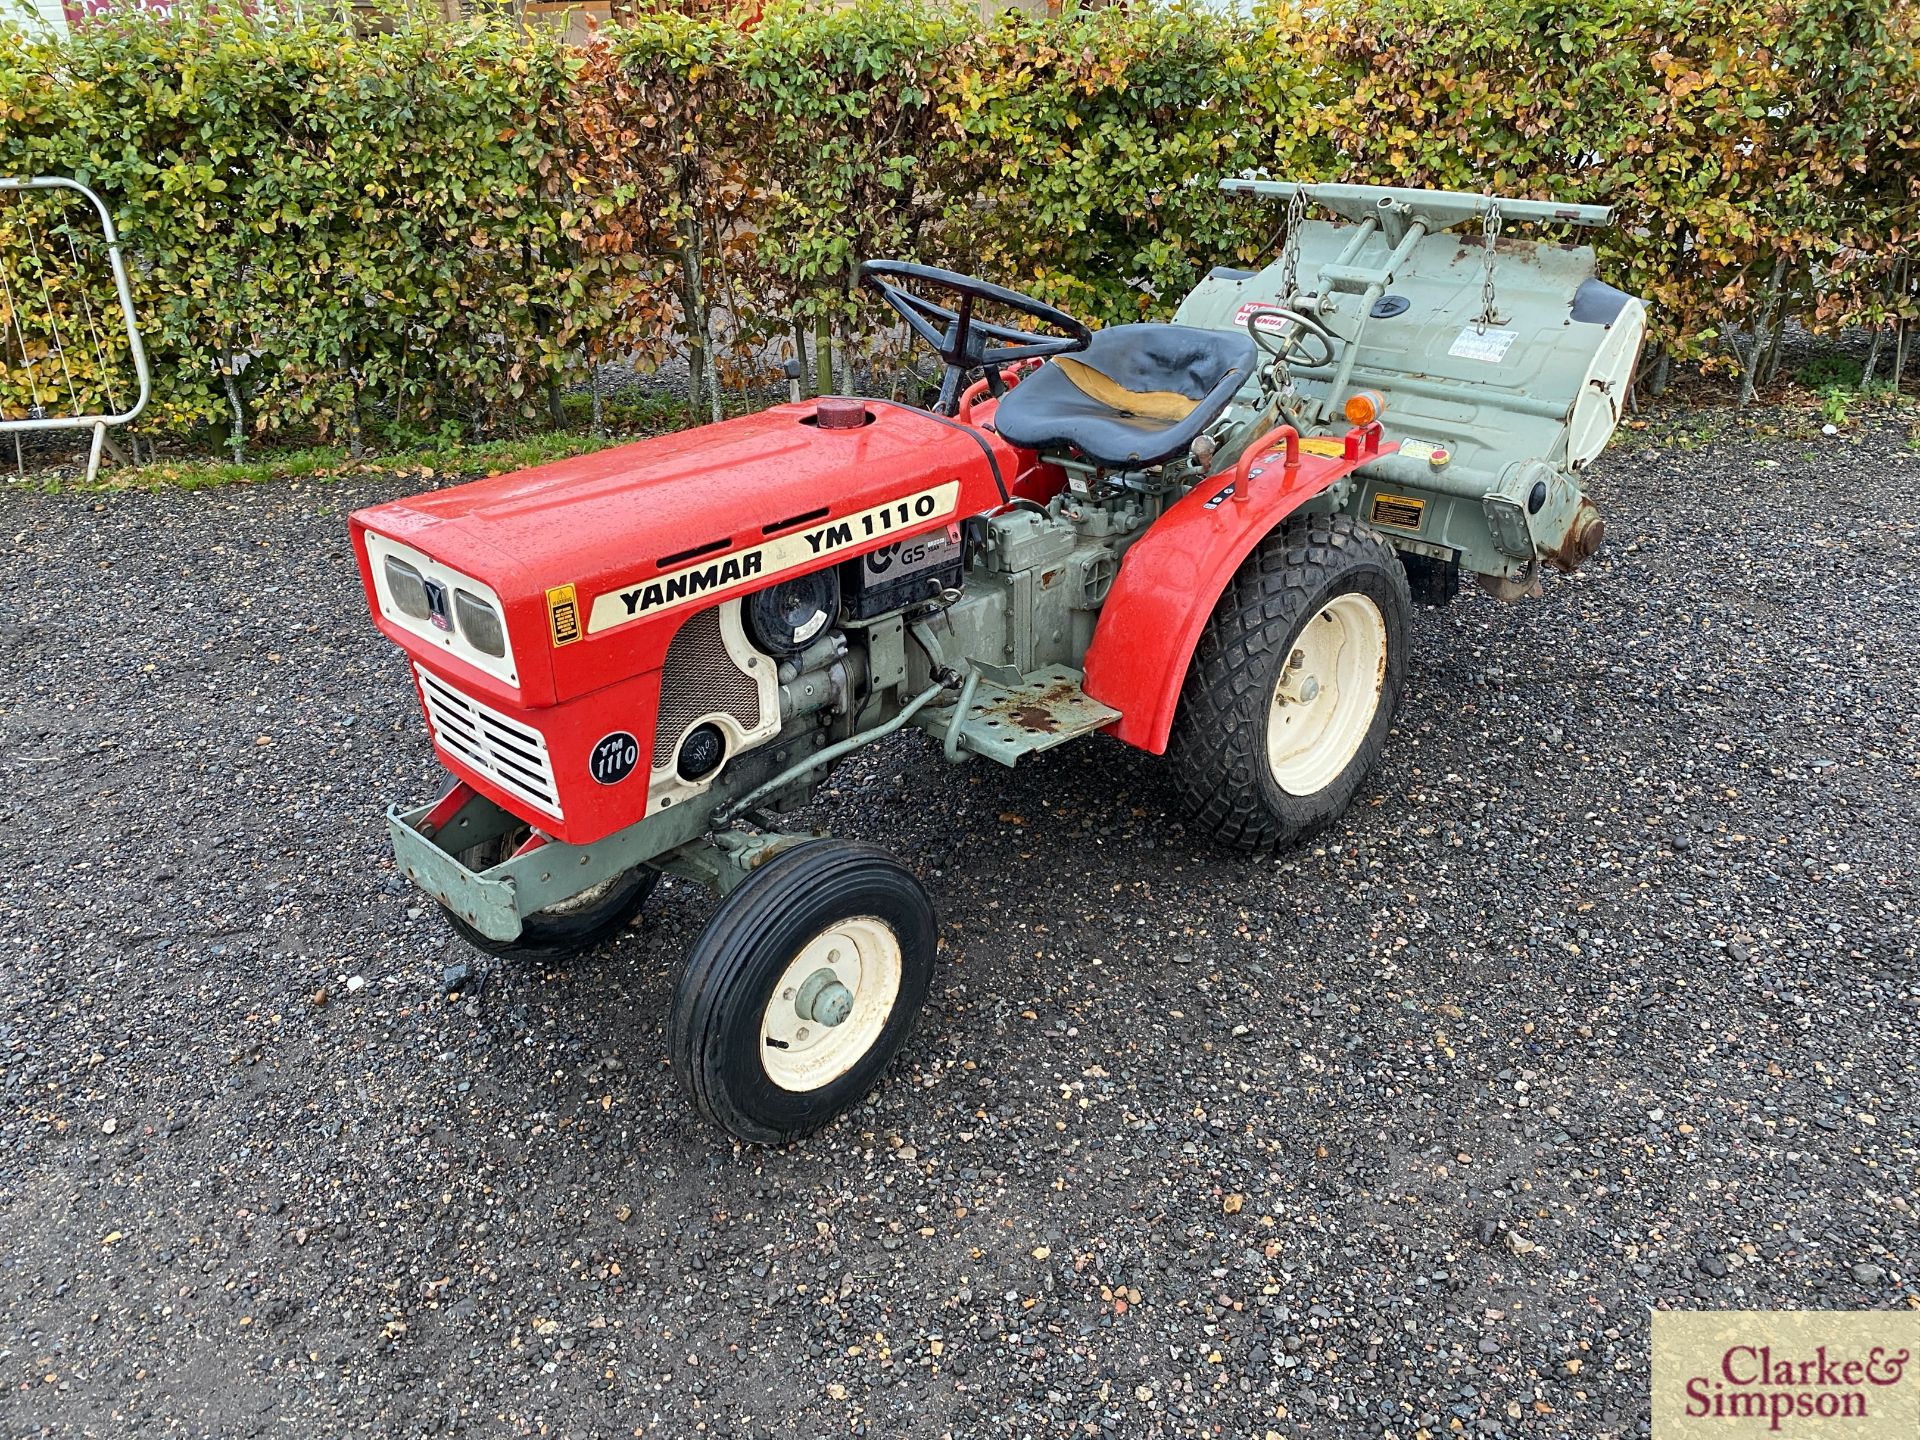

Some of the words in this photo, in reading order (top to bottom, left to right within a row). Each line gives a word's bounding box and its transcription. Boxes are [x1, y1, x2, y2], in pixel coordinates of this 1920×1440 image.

[1237, 315, 1282, 327] YANMR
[619, 550, 763, 615] YANMAR
[804, 522, 853, 554] YM
[861, 495, 935, 536] 1110
[901, 544, 926, 565] GS
[599, 738, 623, 757] YM
[598, 745, 636, 778] 1110
